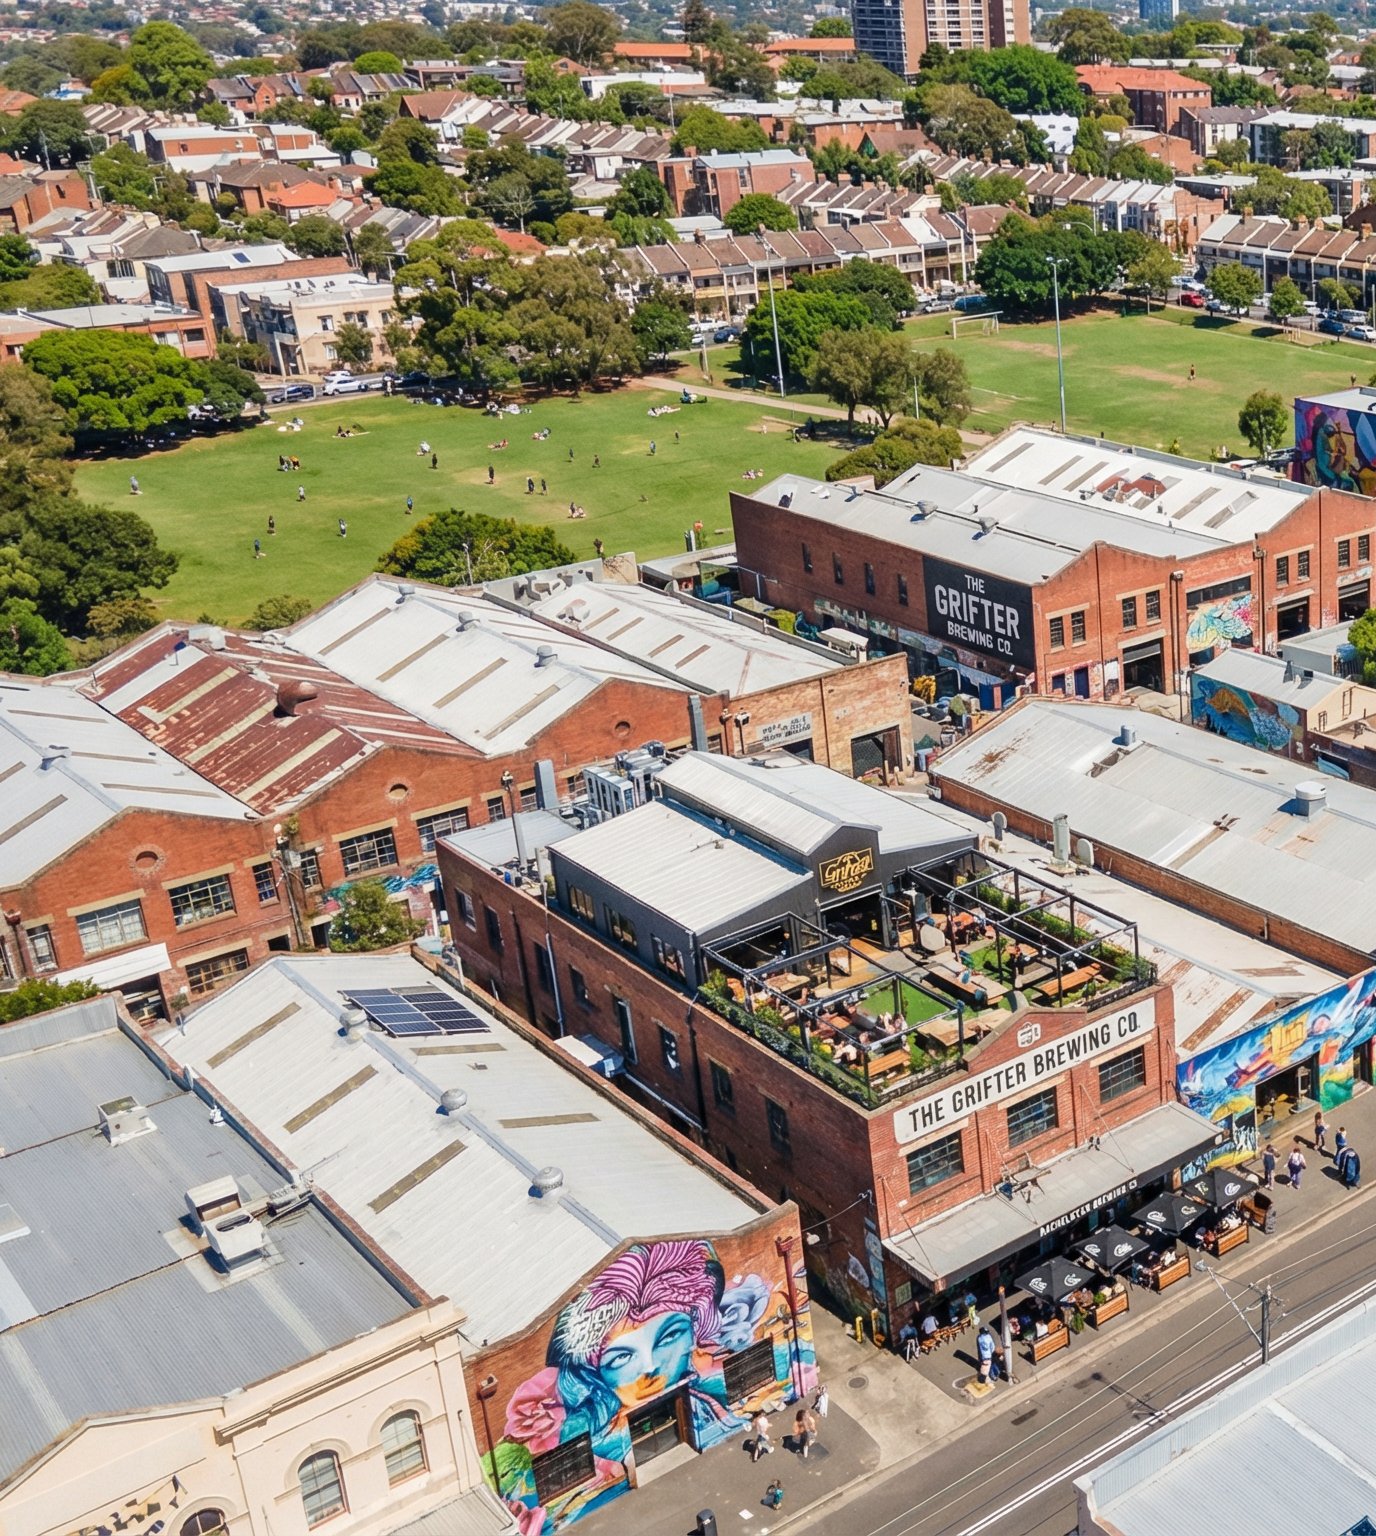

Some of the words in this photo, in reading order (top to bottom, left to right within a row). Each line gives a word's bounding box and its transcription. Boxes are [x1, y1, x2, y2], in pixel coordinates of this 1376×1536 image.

[964, 574, 985, 594] THE
[934, 584, 1020, 640] GRIFTER
[947, 620, 994, 649] BREWING
[908, 1097, 945, 1132] THE
[952, 1062, 1027, 1113] GRIFTER
[1033, 1025, 1111, 1077] BREWING
[1117, 1011, 1141, 1038] CO.
